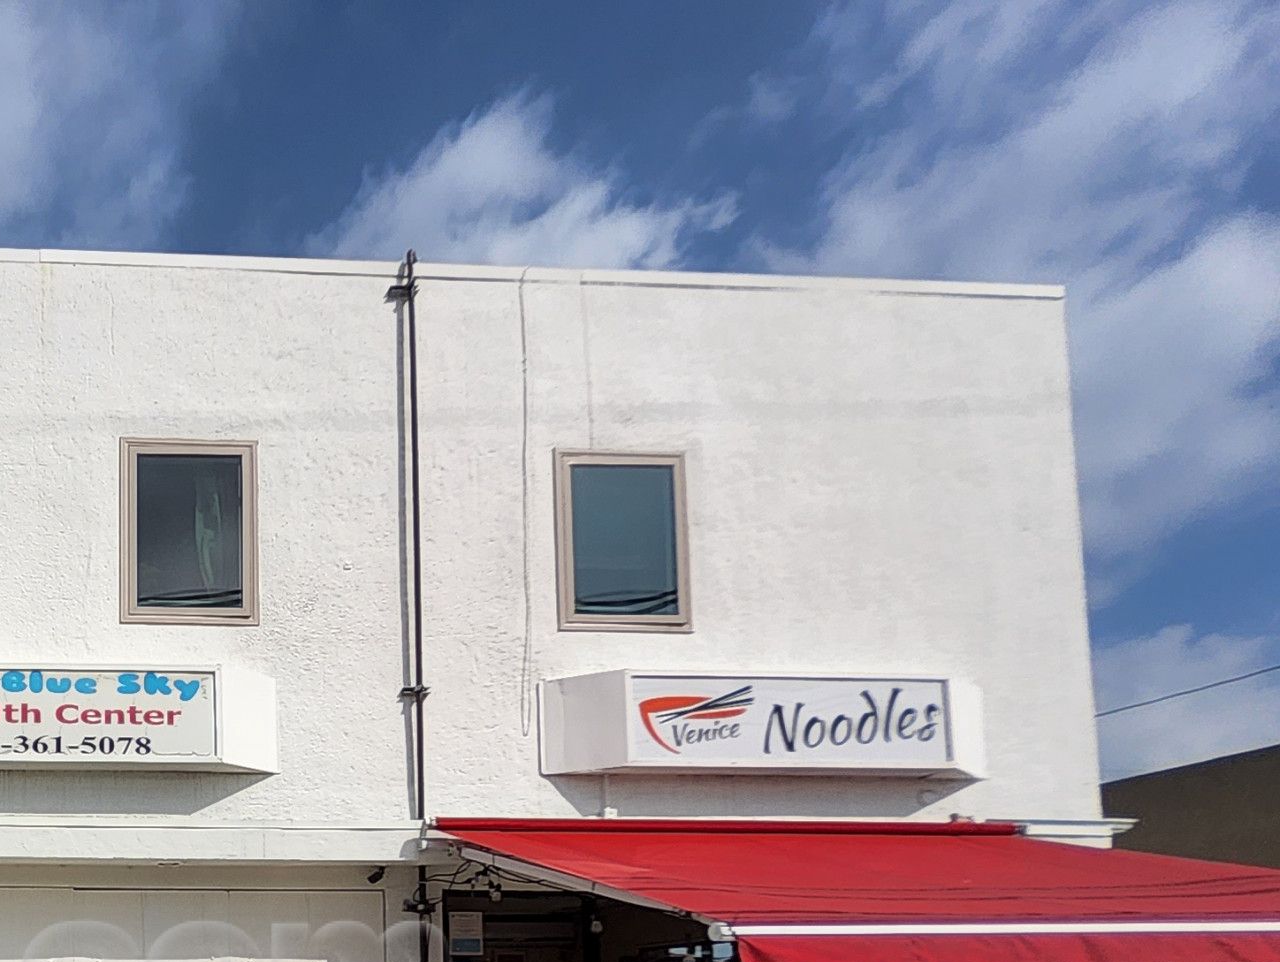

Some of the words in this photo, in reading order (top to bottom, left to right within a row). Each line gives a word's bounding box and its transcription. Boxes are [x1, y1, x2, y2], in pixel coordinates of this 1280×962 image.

[0, 670, 98, 694] Blue
[116, 672, 200, 701] Sky
[55, 704, 182, 726] Center
[671, 721, 742, 747] Venice
[763, 687, 940, 755] Noodles
